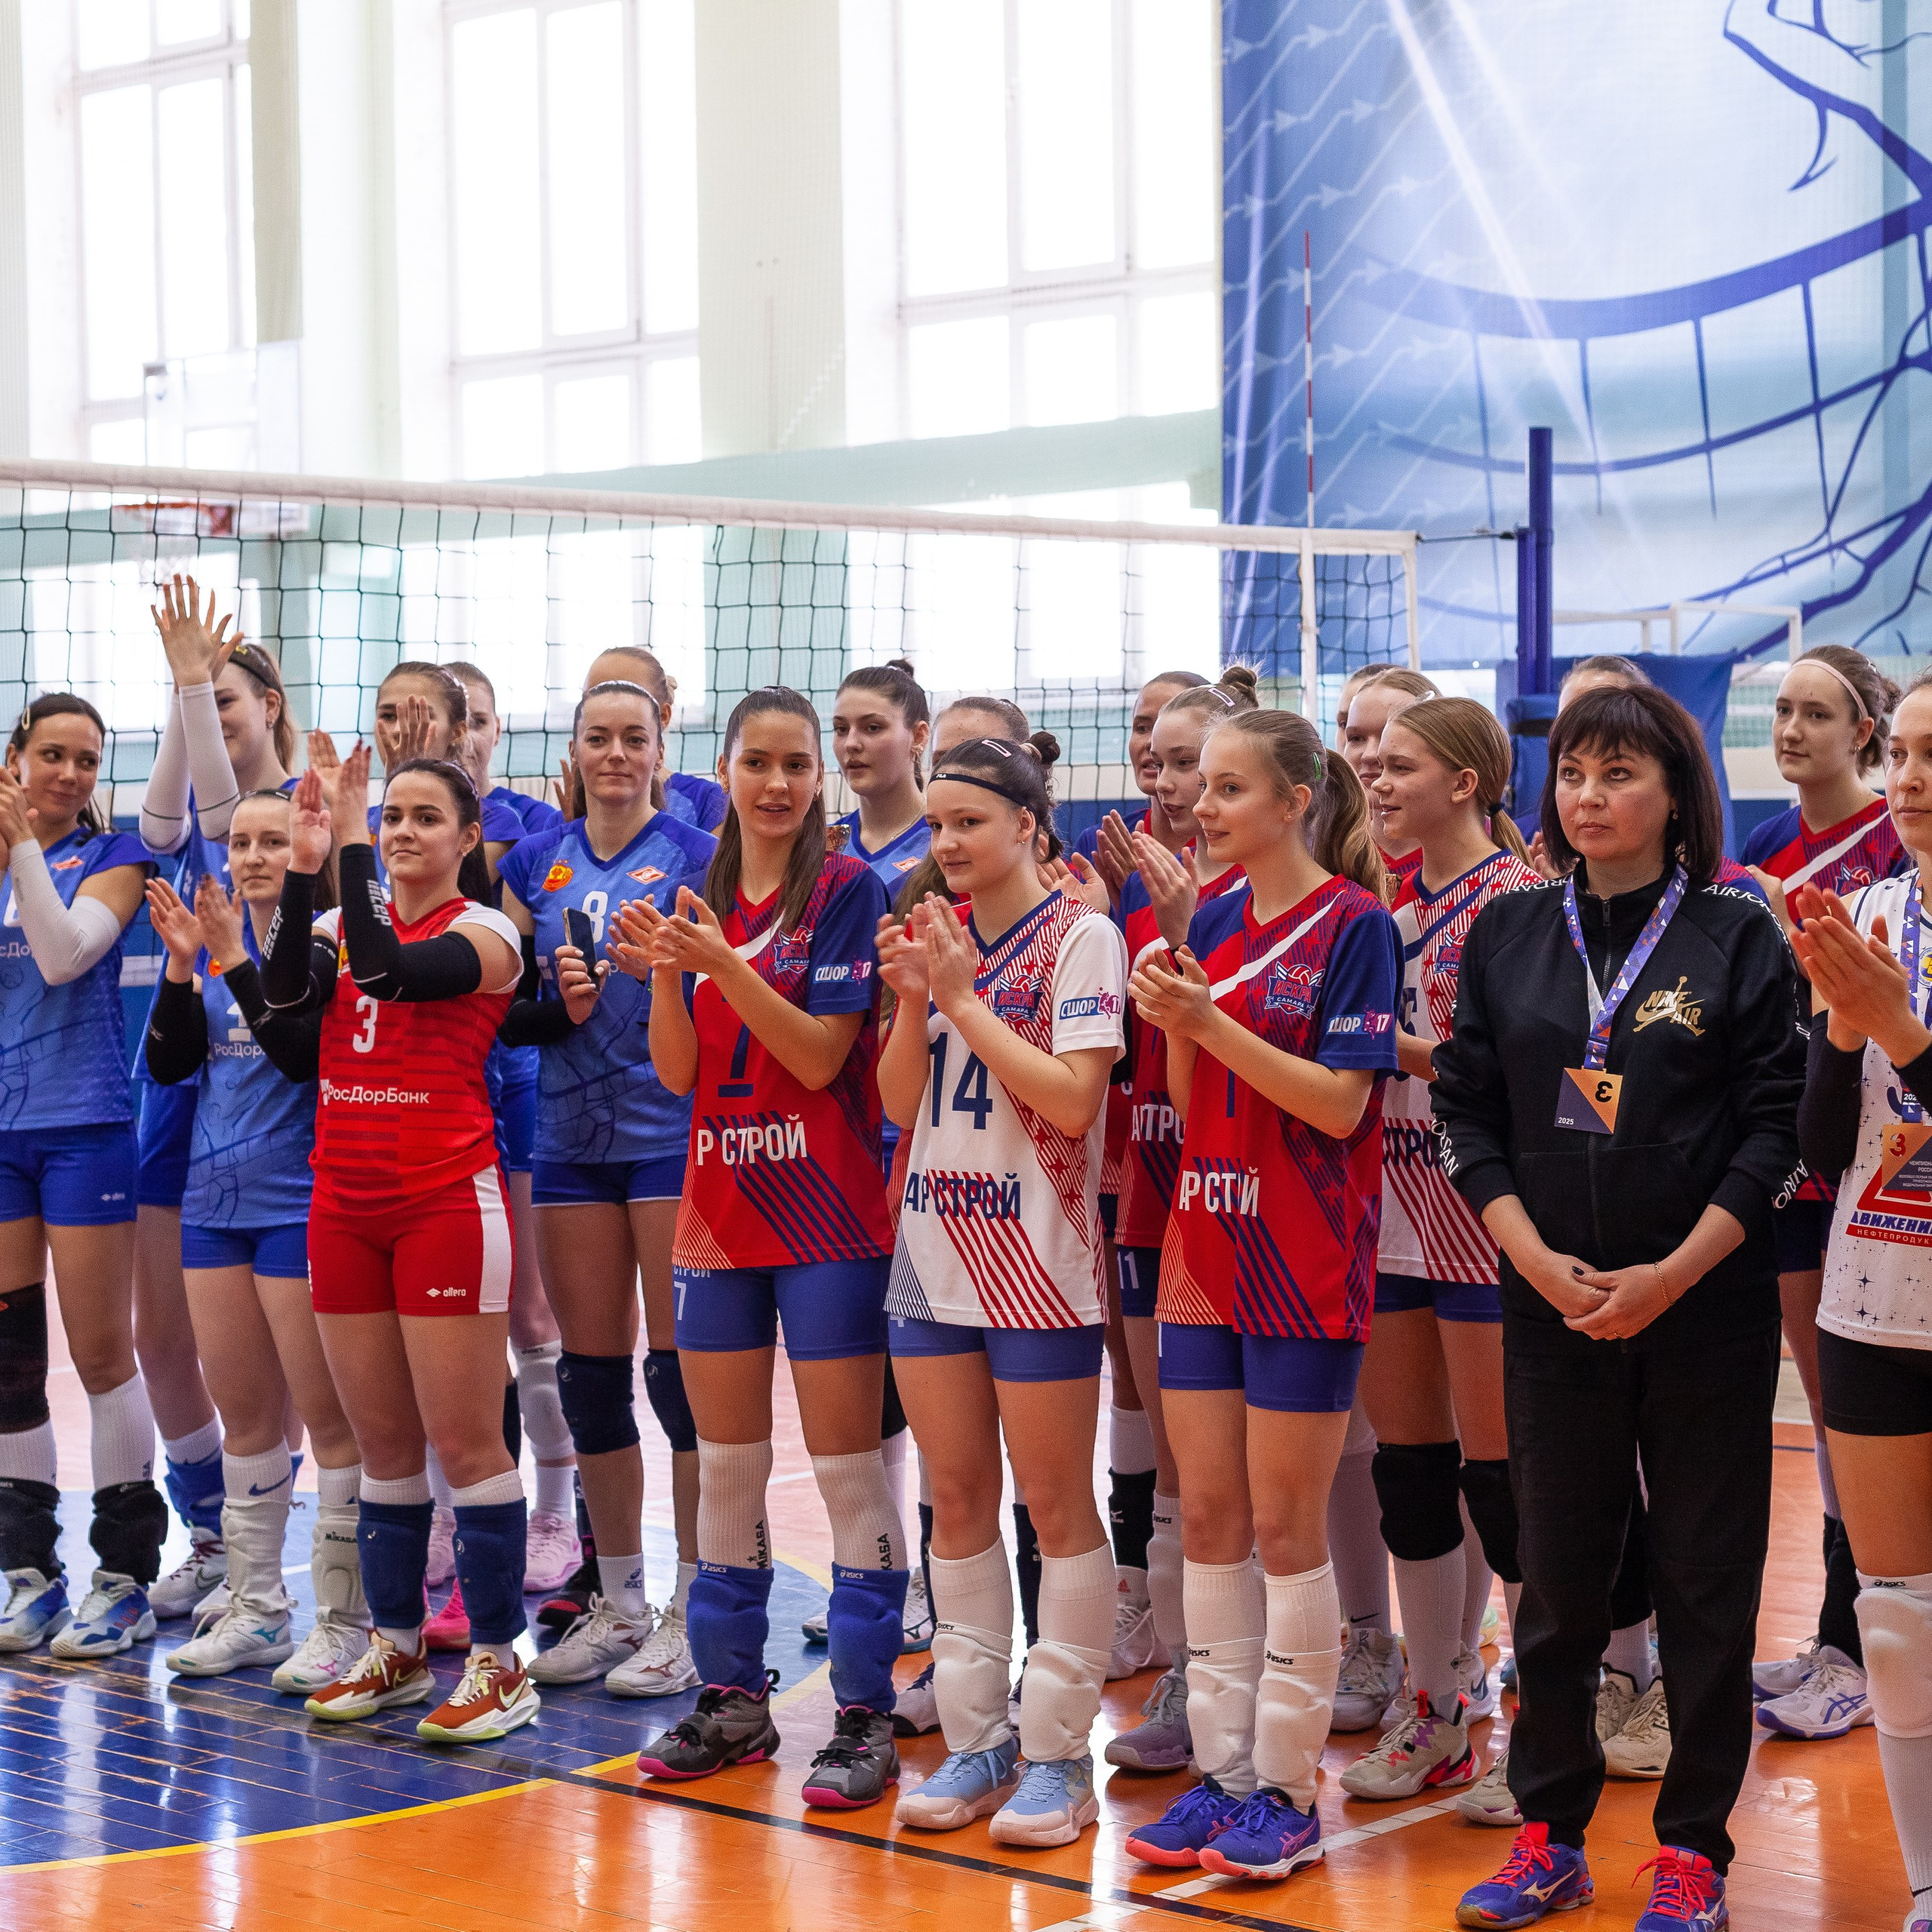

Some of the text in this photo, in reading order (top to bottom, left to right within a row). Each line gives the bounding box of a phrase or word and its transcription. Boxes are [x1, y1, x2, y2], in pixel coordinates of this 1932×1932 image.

[1702, 884, 1740, 897] AIR
[580, 891, 608, 943] 8
[998, 991, 1035, 1008] ИСКРА
[1273, 980, 1312, 1004] ИСКРА
[1277, 996, 1305, 1008] САМАРА
[1645, 990, 1692, 1008] NIKE
[1061, 1000, 1096, 1017] СШОР
[352, 995, 378, 1054] 3
[1377, 1015, 1390, 1032] 17
[929, 1032, 993, 1130] 14
[328, 1084, 430, 1106] РосДорБанк
[1558, 1117, 1574, 1125] 2025
[1889, 1133, 1906, 1158] 3
[1850, 1211, 1932, 1235] ДВИЖЕНИ
[1857, 1229, 1932, 1245] НЕФТЕПРОДУК
[674, 1281, 686, 1321] 7
